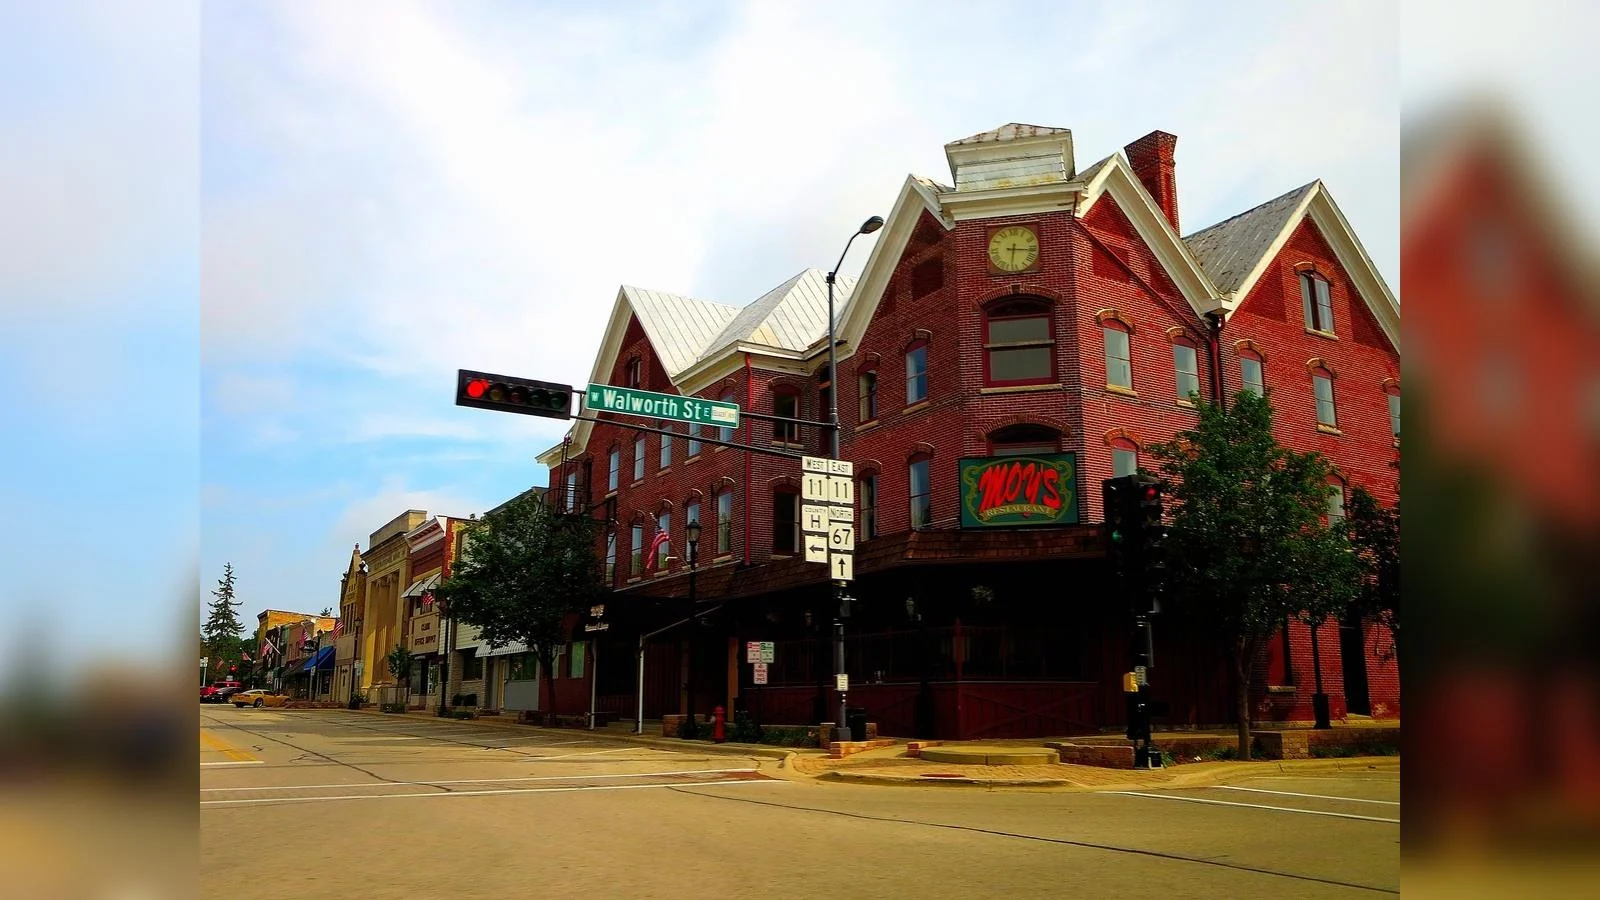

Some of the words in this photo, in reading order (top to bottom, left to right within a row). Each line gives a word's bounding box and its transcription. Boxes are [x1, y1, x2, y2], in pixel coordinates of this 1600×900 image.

[591, 392, 600, 402] W
[603, 389, 678, 416] Walworth
[683, 400, 701, 420] St
[704, 408, 710, 416] E
[806, 460, 824, 470] WEST
[832, 462, 848, 472] EAST
[809, 478, 822, 496] 11
[834, 482, 848, 498] 11
[830, 508, 852, 518] NORTH
[987, 504, 1050, 516] RESTAURANT
[811, 514, 820, 528] H
[833, 528, 850, 545] 67
